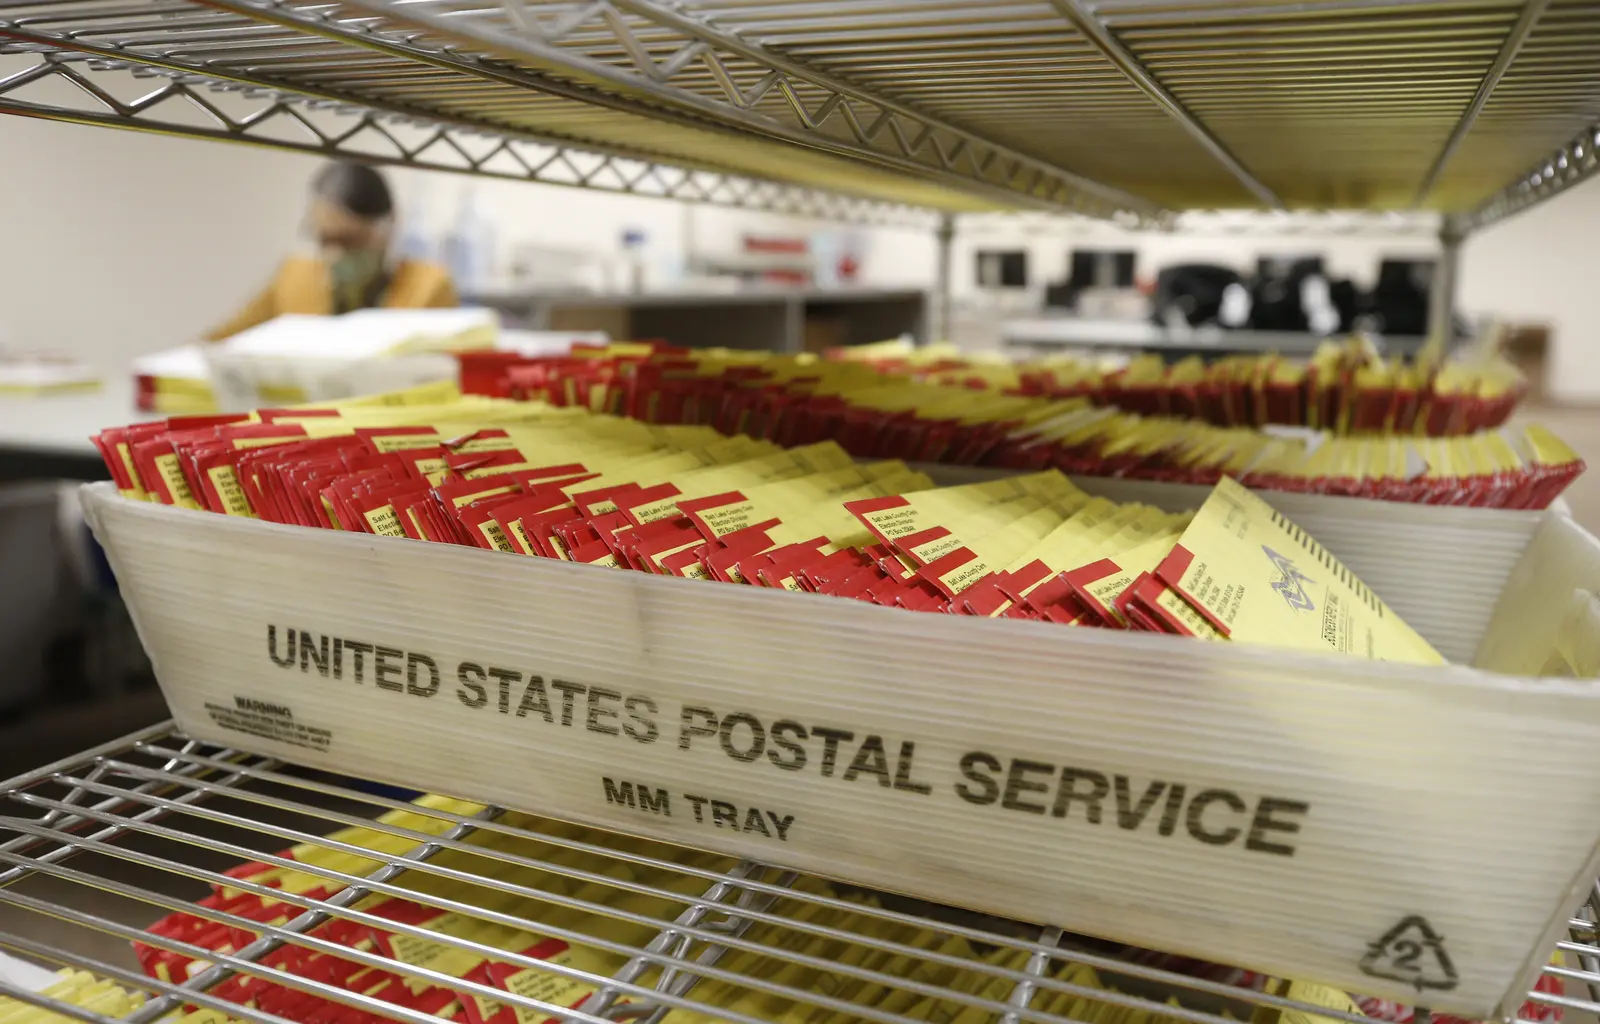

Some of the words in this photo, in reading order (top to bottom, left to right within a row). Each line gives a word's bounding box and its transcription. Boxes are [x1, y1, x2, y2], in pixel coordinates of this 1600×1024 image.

[371, 512, 386, 524] Salt
[638, 509, 650, 518] Salt
[648, 506, 661, 516] Lake
[704, 512, 716, 520] Salt
[714, 509, 727, 517] Lake
[726, 507, 743, 516] County
[871, 514, 883, 523] Salt
[881, 512, 893, 521] Lake
[891, 510, 909, 519] County
[711, 519, 730, 528] Election
[729, 514, 748, 524] Division
[879, 519, 898, 529] Election
[896, 517, 915, 526] Division
[488, 526, 500, 535] Salt
[716, 526, 726, 534] PO
[724, 525, 735, 533] Box
[919, 548, 929, 557] Salt
[928, 545, 939, 553] Lake
[936, 541, 952, 551] County
[949, 538, 961, 546] Clerk
[689, 569, 701, 579] Salt
[947, 577, 958, 587] Salt
[956, 573, 967, 582] Lake
[963, 566, 979, 578] County
[975, 562, 987, 571] Clerk
[1109, 580, 1125, 589] County
[233, 695, 292, 719] WARNING
[267, 624, 440, 699] UNITED
[456, 661, 661, 744] STATES
[678, 704, 931, 796] POSTAL
[953, 751, 1310, 857] SERVICE
[602, 777, 672, 817] MM
[683, 793, 794, 842] TRAY
[1392, 939, 1422, 973] 2
